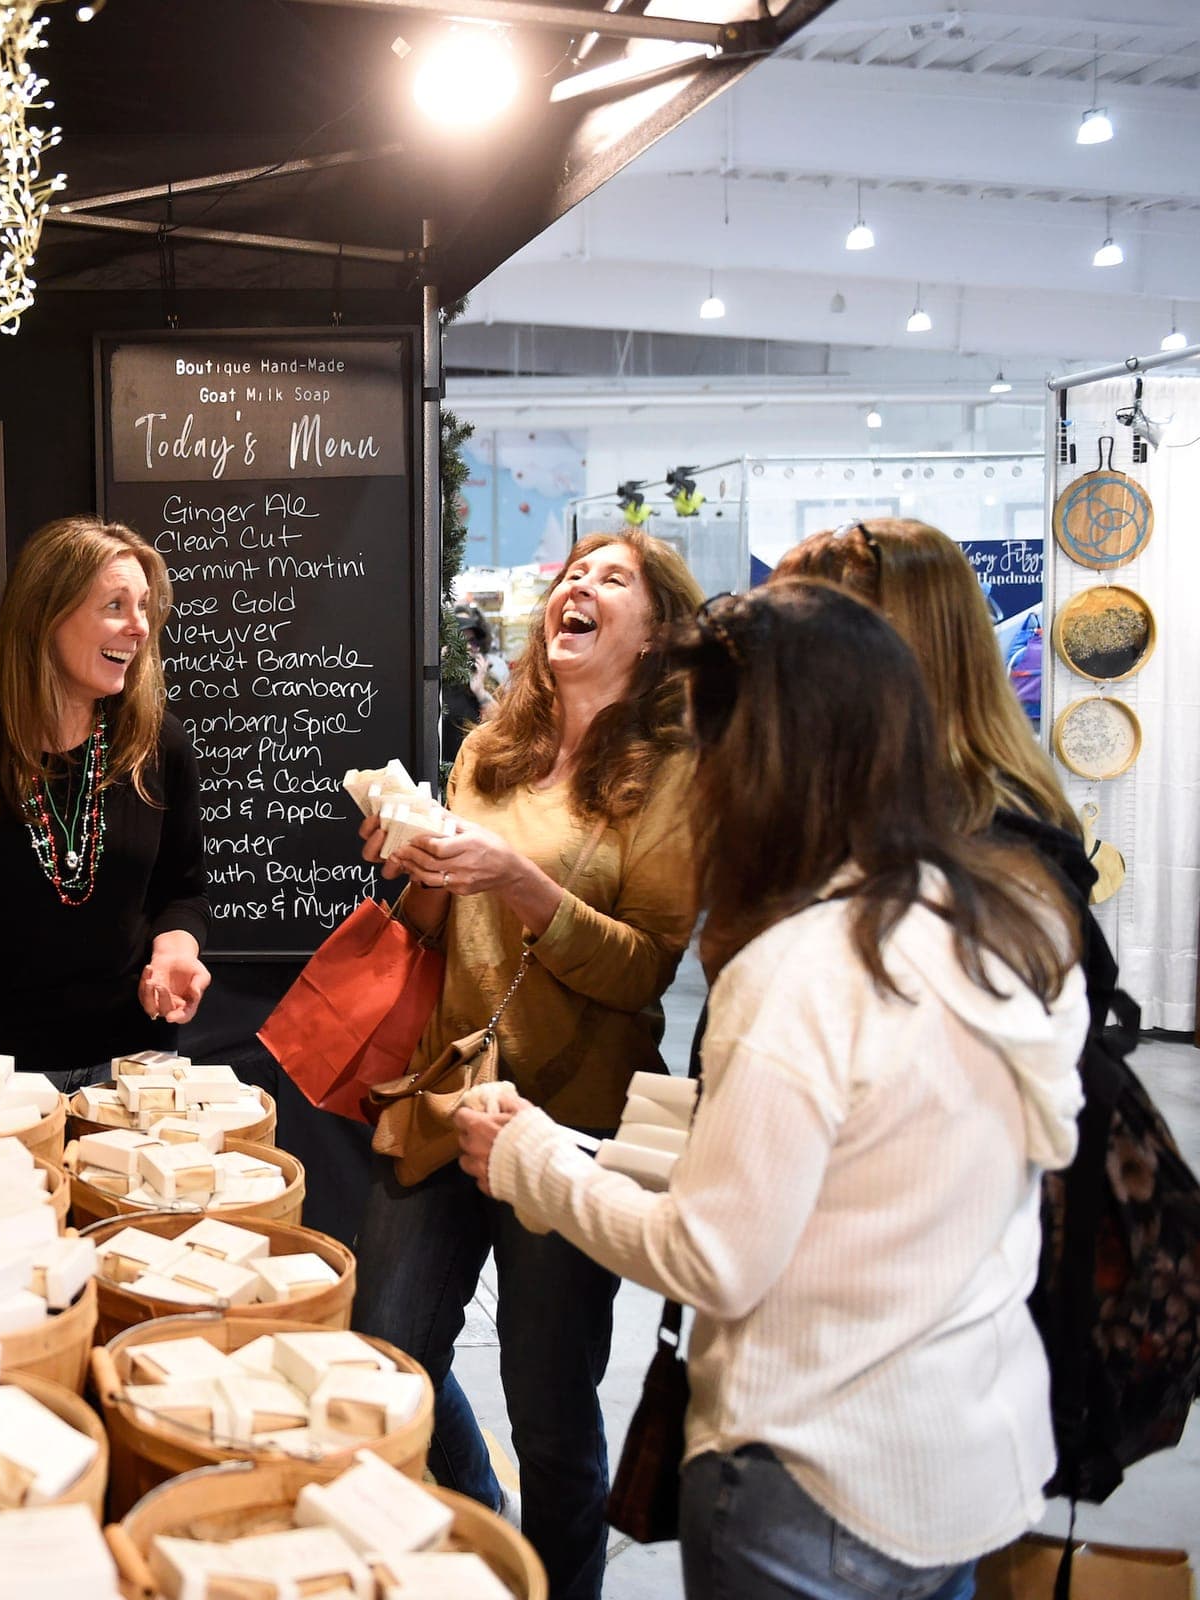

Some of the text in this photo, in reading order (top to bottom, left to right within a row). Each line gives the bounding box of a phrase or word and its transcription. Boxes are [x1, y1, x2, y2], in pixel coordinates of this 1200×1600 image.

[175, 358, 346, 376] Boutique Hand-Made
[199, 386, 331, 405] Goat Milk Soap
[134, 410, 381, 480] Today's Menu
[162, 493, 320, 535] Ginger Ale
[154, 524, 303, 554] Clean Cut
[268, 552, 367, 580] Martini
[231, 587, 296, 614] Gold
[164, 620, 292, 654] Vetyver
[160, 644, 374, 673] ntucket Bramble
[189, 677, 240, 699] Cod
[251, 676, 379, 717] Cranberry
[292, 708, 362, 741] Spice
[192, 736, 323, 775] Sugar Plum
[246, 763, 265, 791] &
[273, 768, 344, 794] Cedar
[239, 797, 254, 821] &
[266, 799, 347, 825] Apple
[266, 860, 378, 898] Bayberry
[271, 888, 286, 921] &
